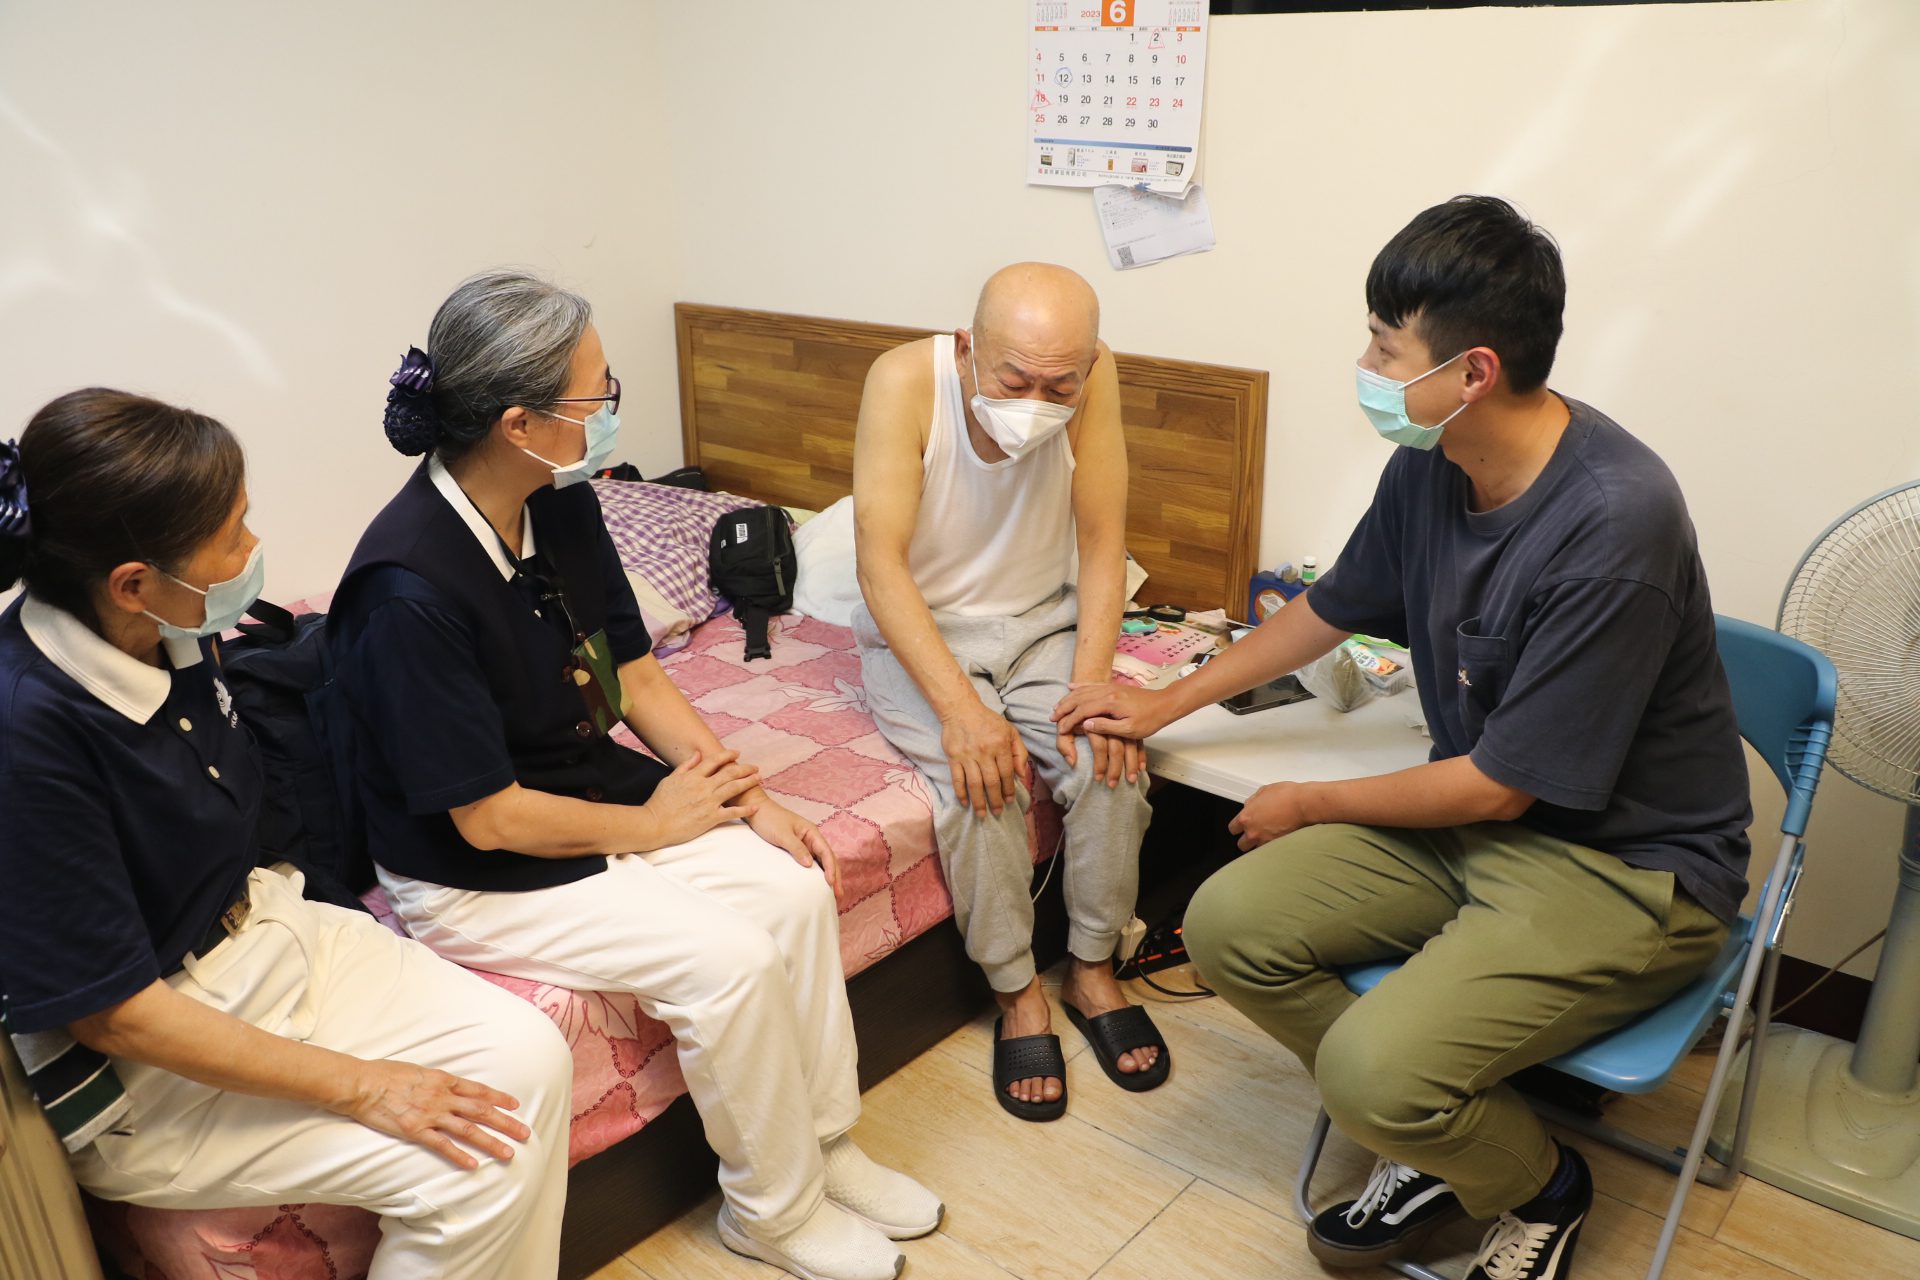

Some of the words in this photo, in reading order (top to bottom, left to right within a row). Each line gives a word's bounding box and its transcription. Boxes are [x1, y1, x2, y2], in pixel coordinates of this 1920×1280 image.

[1080, 10, 1101, 18] 2023
[1109, 0, 1127, 24] 6
[1129, 33, 1135, 42] 1
[1153, 32, 1160, 42] 2
[1176, 33, 1183, 42] 3
[1036, 53, 1042, 61] 4
[1059, 53, 1065, 62] 5
[1081, 53, 1088, 62] 6
[1105, 53, 1111, 63] 7
[1128, 54, 1135, 63] 8
[1152, 54, 1158, 63] 9
[1176, 55, 1187, 65] 10
[1036, 73, 1045, 82] 11
[1059, 74, 1069, 83] 12
[1082, 74, 1092, 83] 13
[1105, 75, 1115, 84] 14
[1128, 75, 1138, 84] 15
[1151, 75, 1162, 85] 16
[1174, 76, 1185, 86] 17
[1036, 94, 1046, 103] 18
[1058, 94, 1069, 103] 19
[1080, 95, 1092, 104] 20
[1103, 95, 1114, 105] 21
[1126, 96, 1137, 106] 22
[1149, 97, 1160, 107] 23
[1172, 98, 1183, 108] 24
[1035, 114, 1046, 123] 25
[1057, 115, 1068, 124] 26
[1080, 115, 1090, 125] 27
[1102, 116, 1113, 126] 28
[1125, 118, 1136, 127] 29
[1147, 119, 1159, 128] 30
